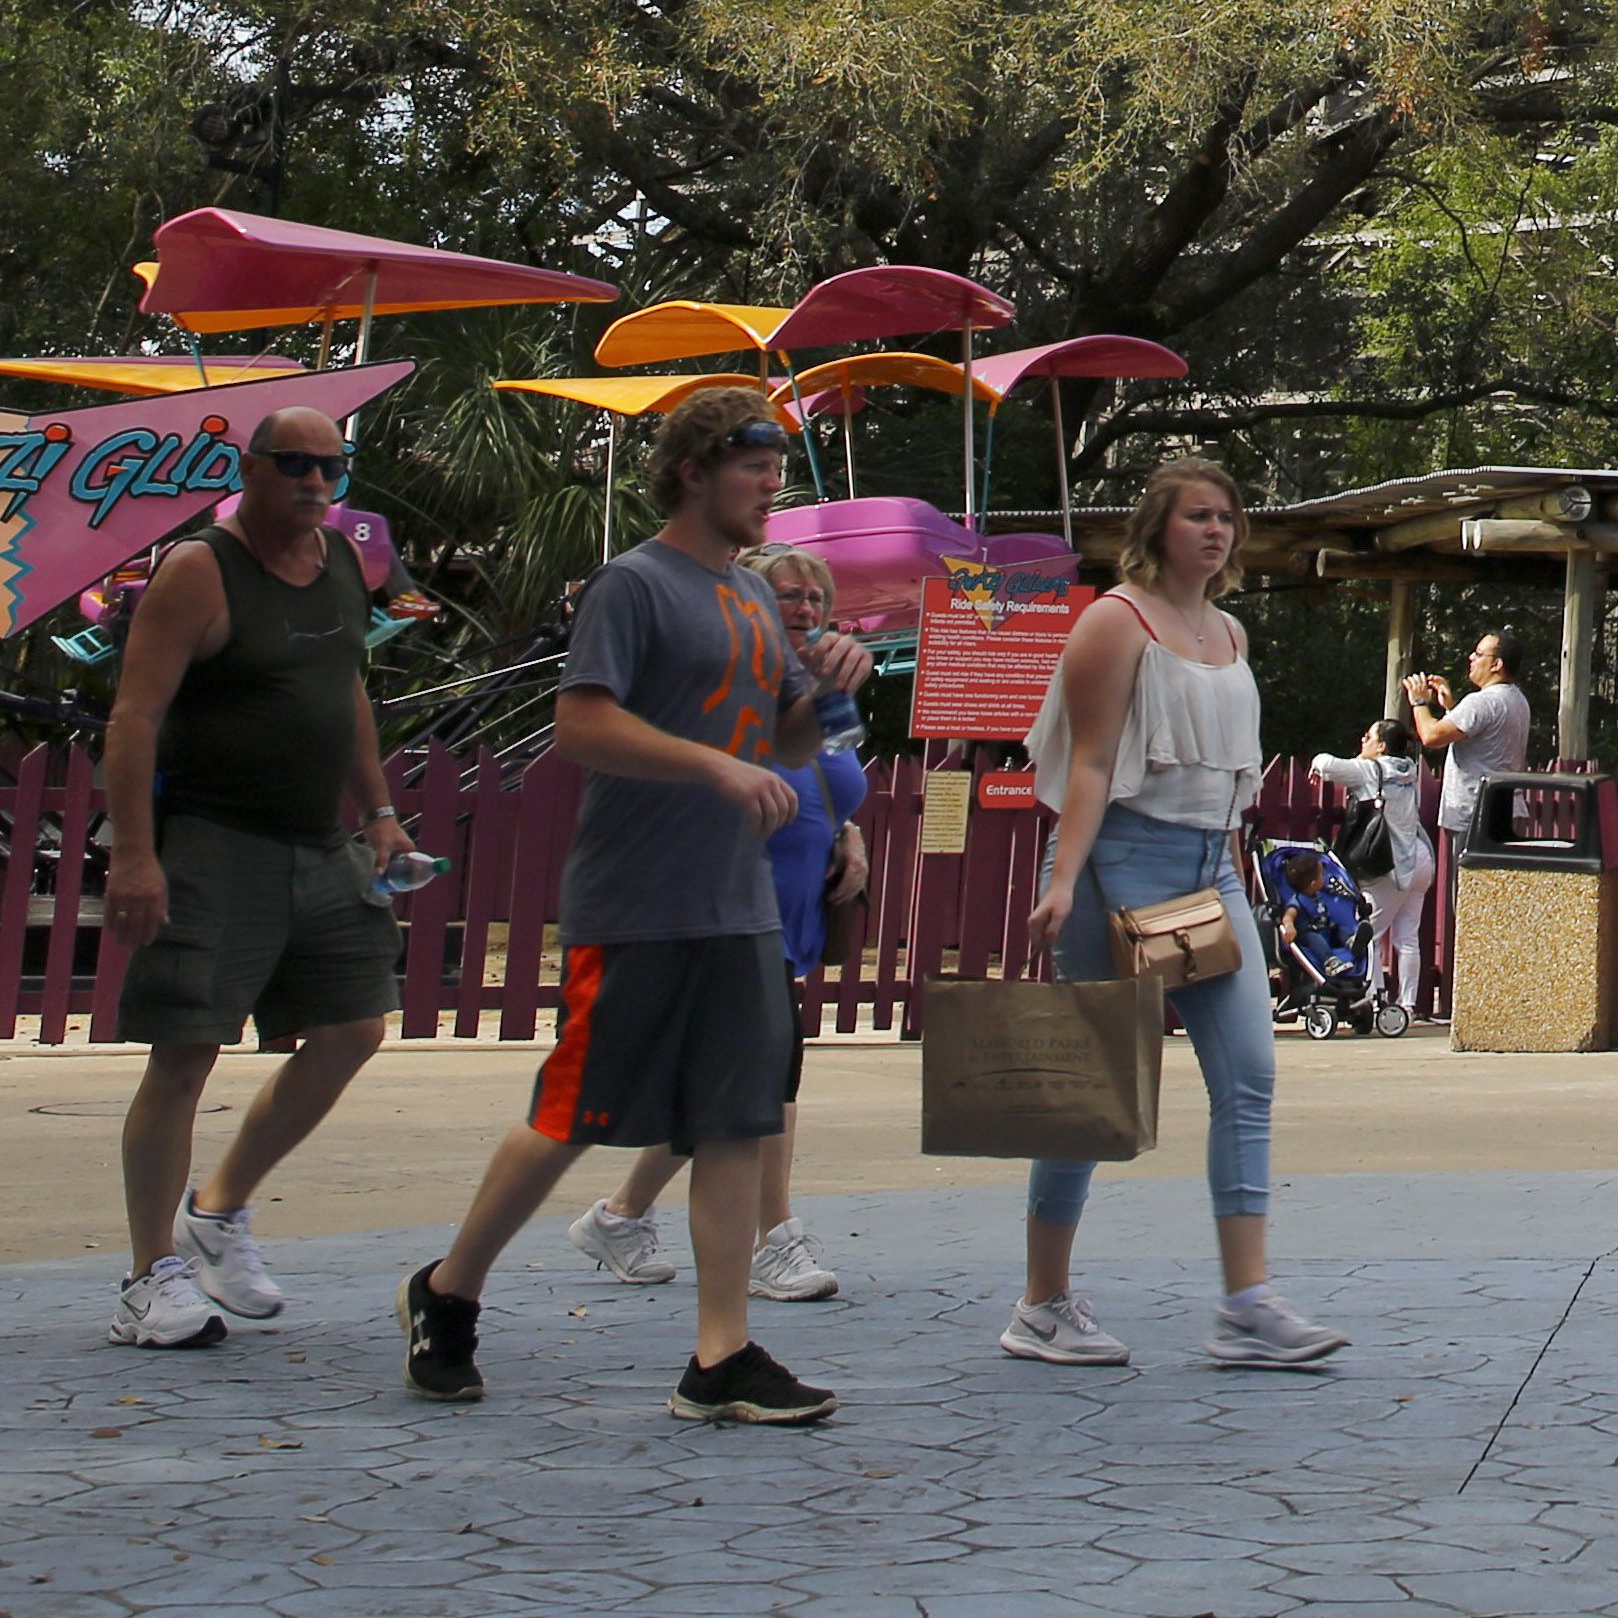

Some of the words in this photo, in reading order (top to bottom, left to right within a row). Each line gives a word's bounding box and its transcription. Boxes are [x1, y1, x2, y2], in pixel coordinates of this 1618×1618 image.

[70, 414, 358, 530] GLID
[354, 522, 370, 541] 8
[951, 598, 973, 610] Ride
[974, 599, 1005, 614] Safety
[1006, 601, 1070, 615] Requirements
[986, 784, 1032, 796] Entrance
